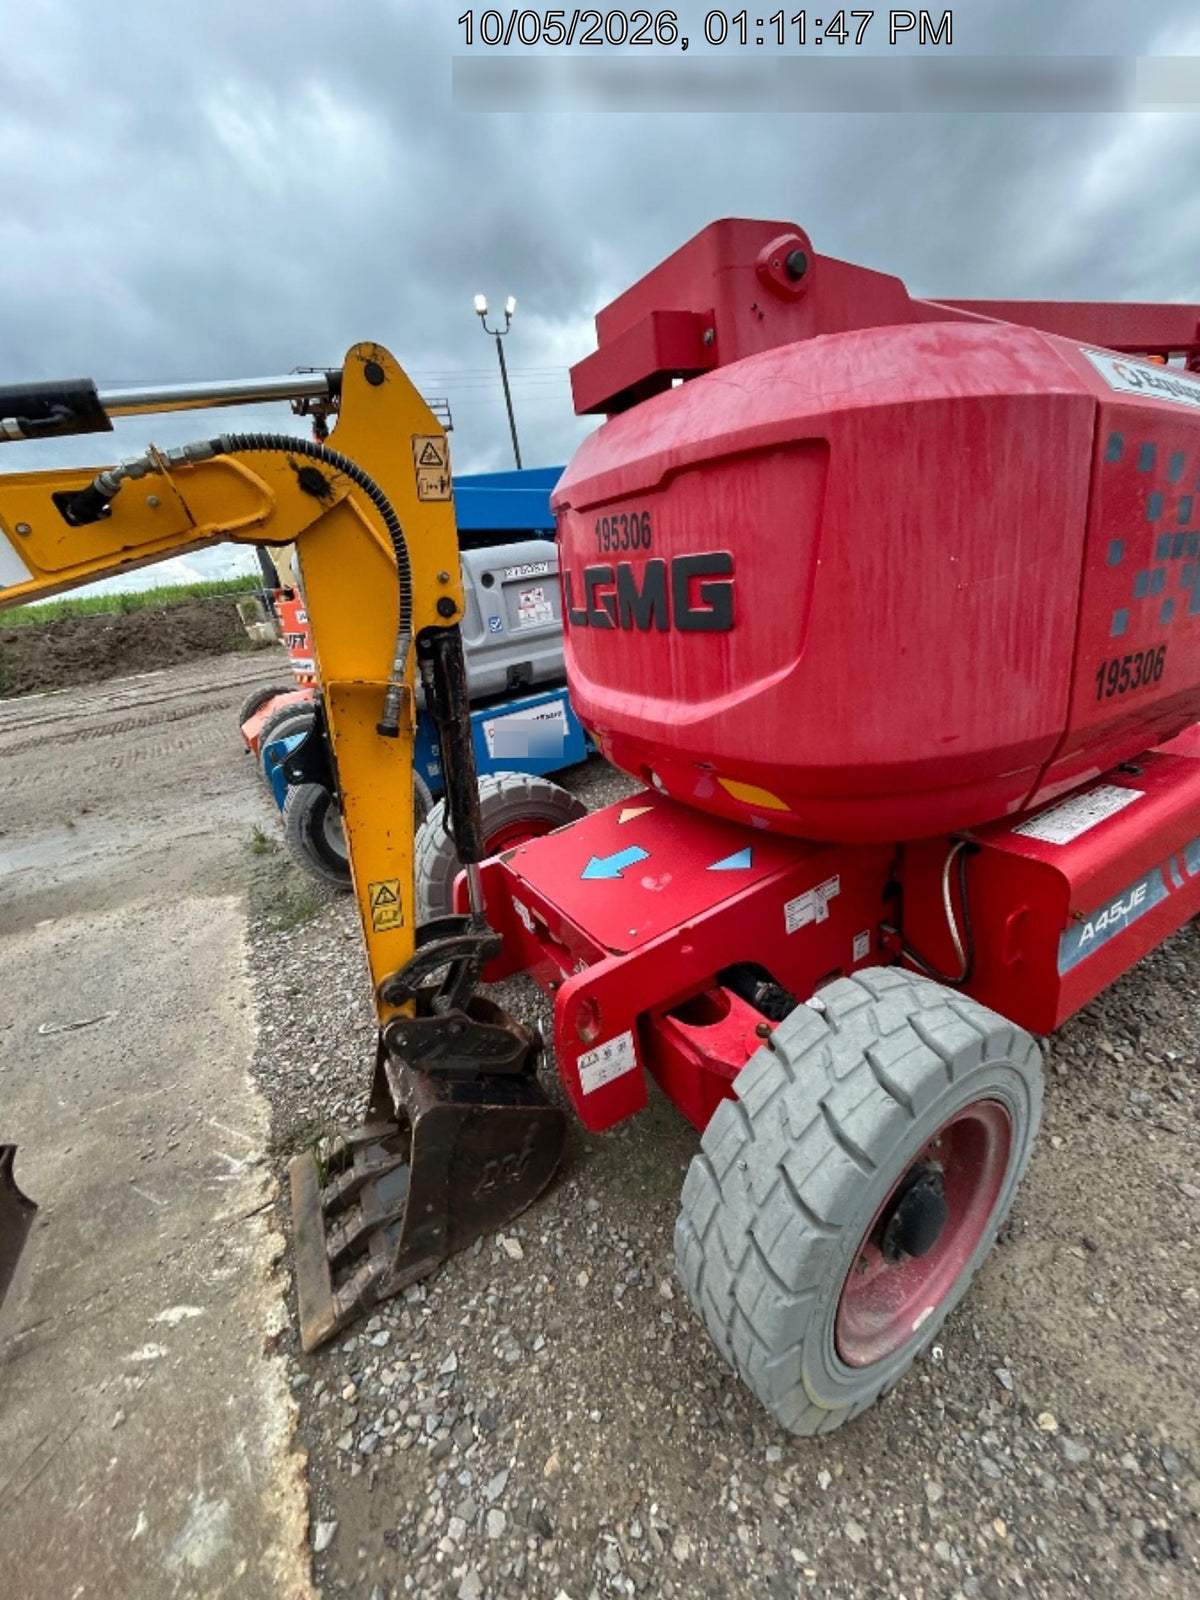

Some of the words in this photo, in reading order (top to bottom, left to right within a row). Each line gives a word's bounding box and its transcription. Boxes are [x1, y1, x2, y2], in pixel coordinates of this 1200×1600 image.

[595, 510, 652, 552] 195306
[564, 551, 735, 632] LGMG
[1096, 645, 1167, 701] 195306
[1077, 882, 1148, 947] A45JE
